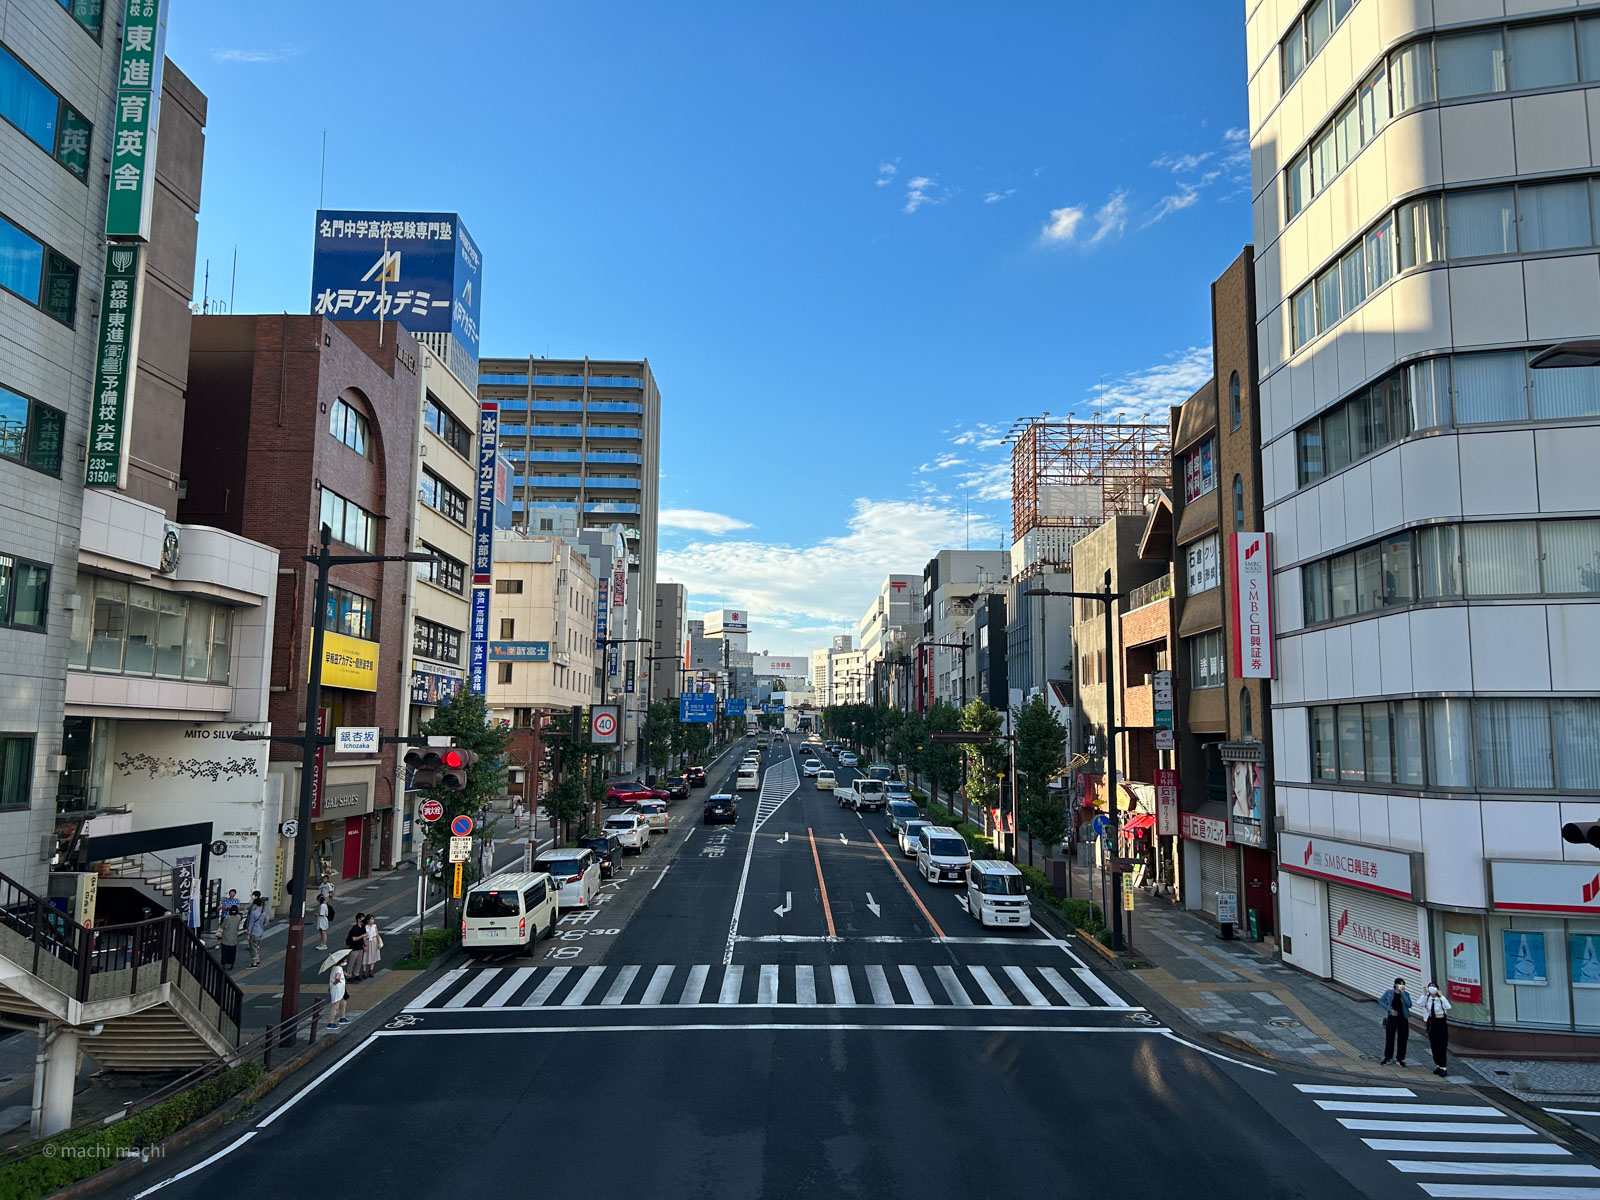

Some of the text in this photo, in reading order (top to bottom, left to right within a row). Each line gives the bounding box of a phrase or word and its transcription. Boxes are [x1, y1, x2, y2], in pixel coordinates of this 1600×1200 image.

[115, 25, 153, 191] 東進育英舎
[320, 219, 452, 240] 名門中学高校受験専門塾
[315, 289, 450, 316] 水戸アカデミー
[95, 423, 116, 452] 水戸校
[89, 458, 113, 470] 233-
[477, 417, 496, 569] 水戸アカデミー 本部校
[1249, 579, 1262, 669] SMBC日興証券
[516, 646, 546, 656] 武富士
[473, 645, 483, 691] 水戸一高合格
[184, 730, 211, 739] MITO
[340, 731, 375, 742] 銀杏坂
[599, 719, 612, 730] 40
[340, 794, 359, 808] SHOES
[1192, 818, 1224, 843] 石倉クリニック
[1324, 853, 1378, 878] SMBC日興証券
[1352, 922, 1420, 959] SMBC日興証券
